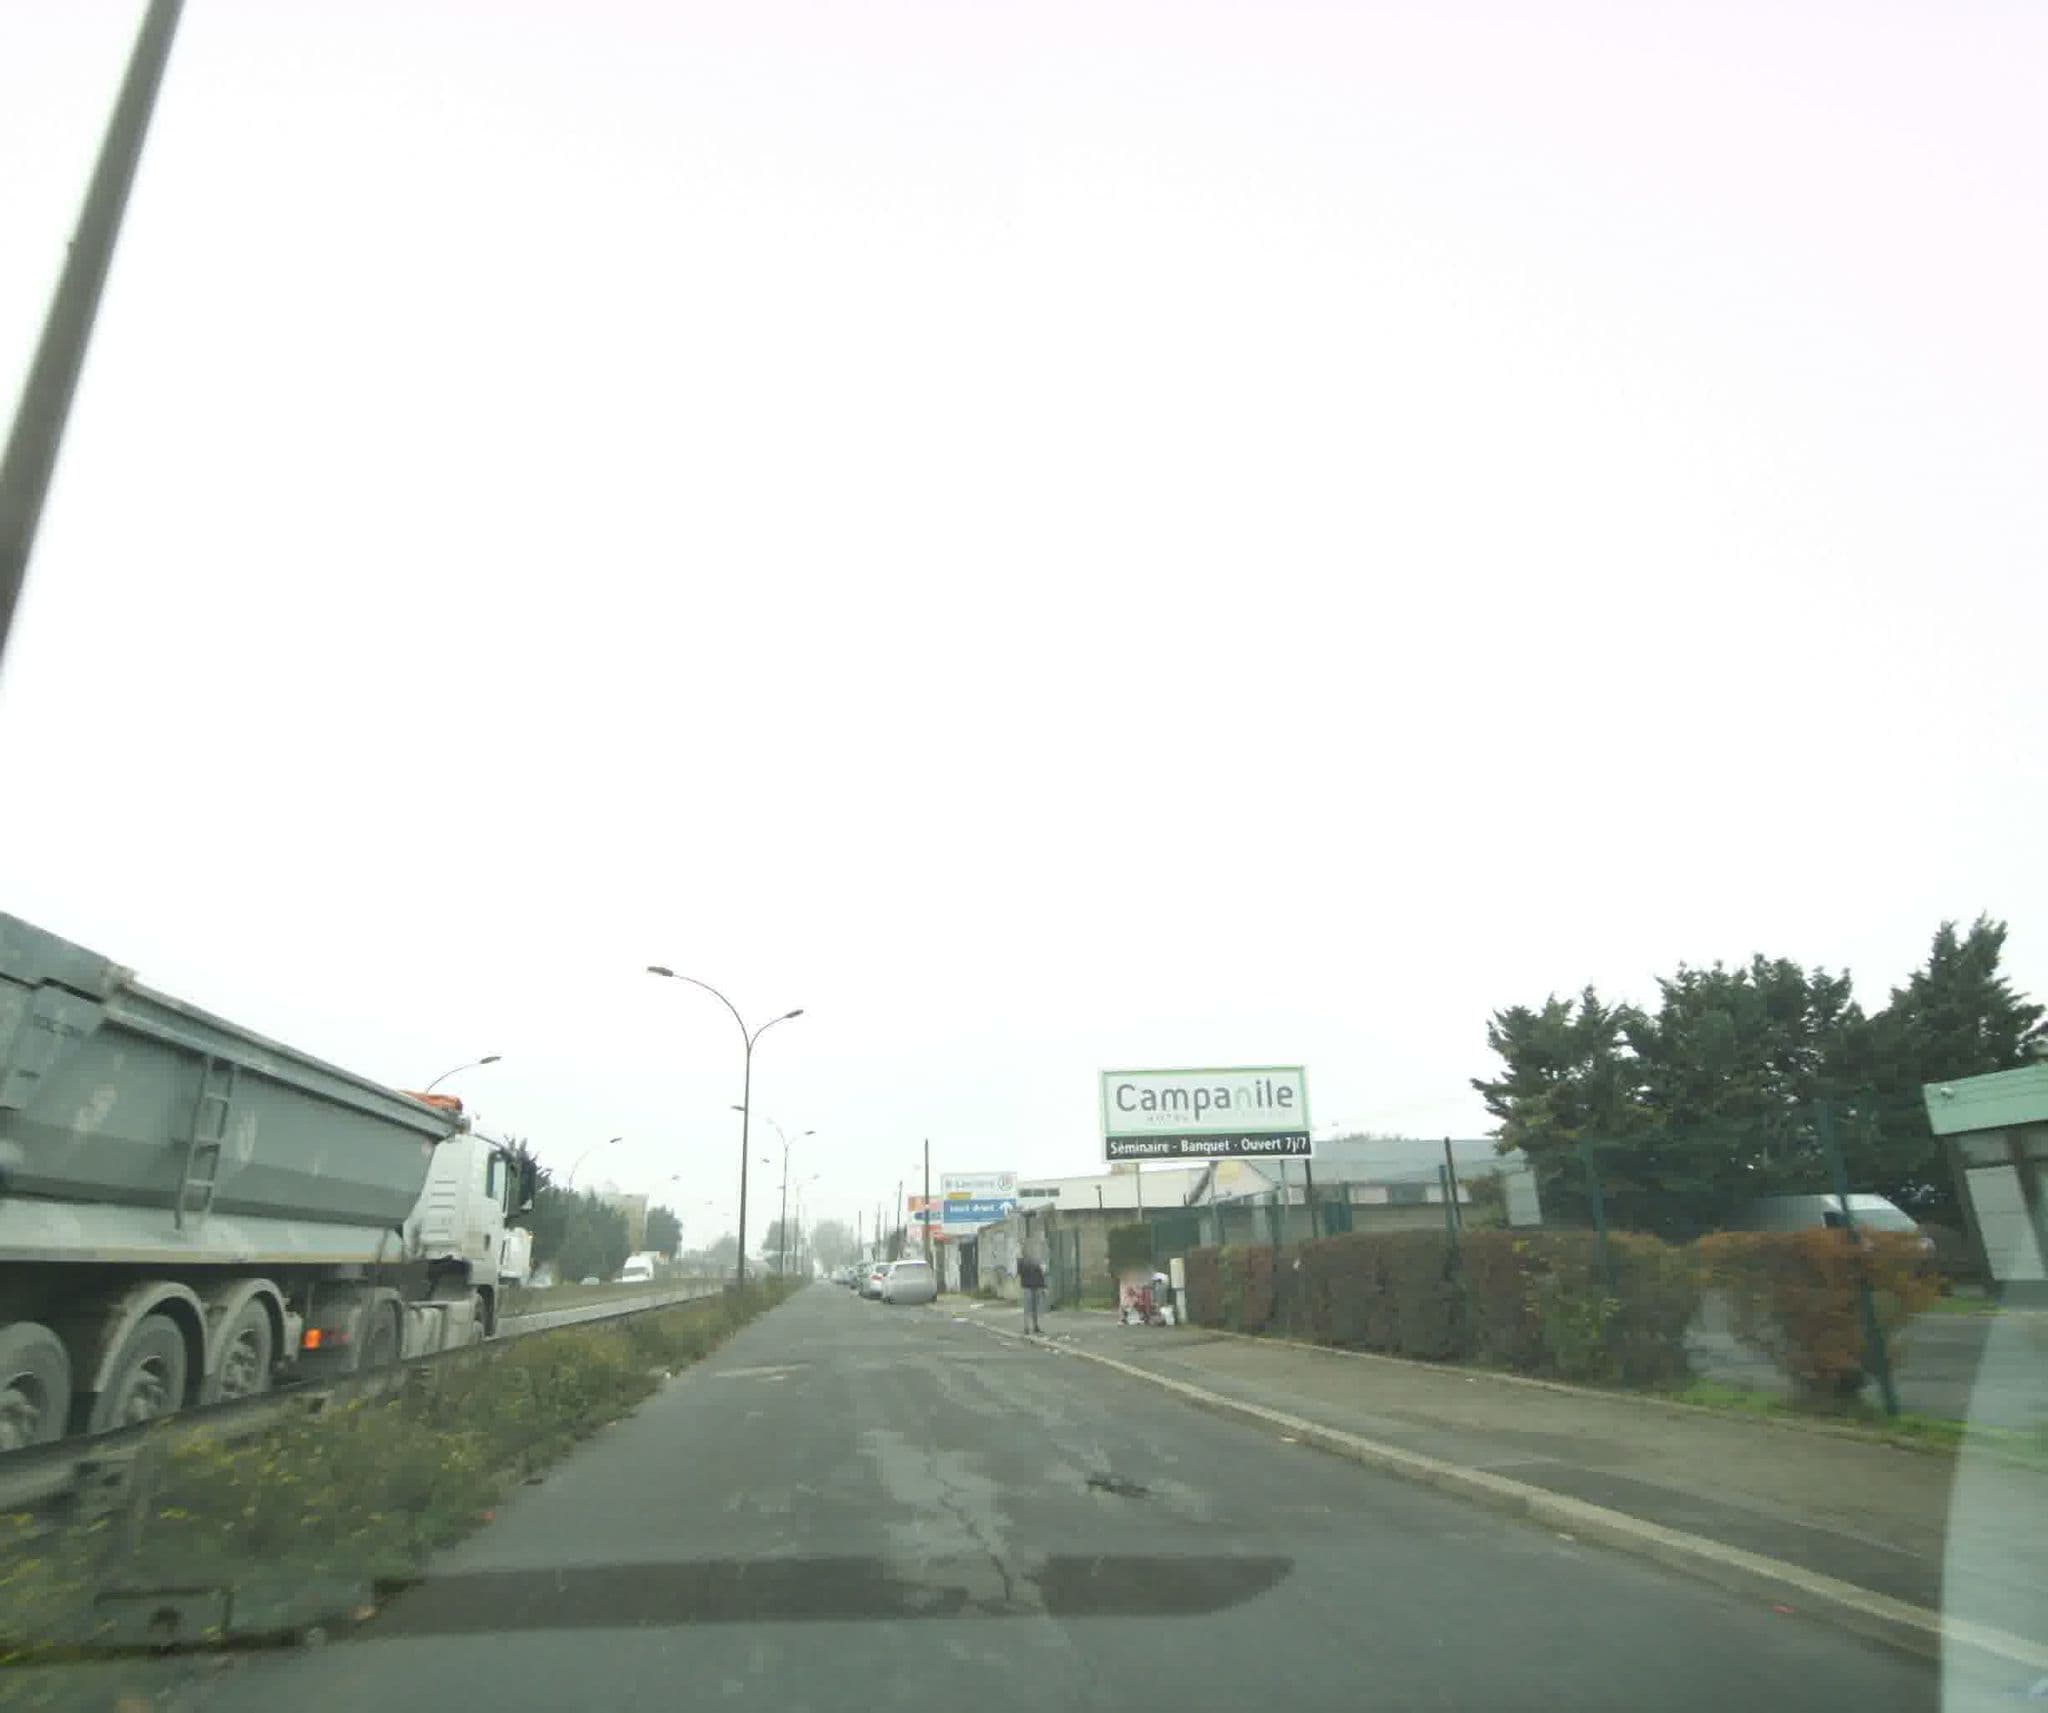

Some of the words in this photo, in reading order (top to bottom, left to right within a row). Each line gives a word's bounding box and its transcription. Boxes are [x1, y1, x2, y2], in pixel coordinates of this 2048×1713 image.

[1116, 1078, 1294, 1122] Campanile
[1181, 1139, 1230, 1155] Banquet
[1241, 1137, 1282, 1151] Ouvert
[1285, 1136, 1307, 1153] 7j/7
